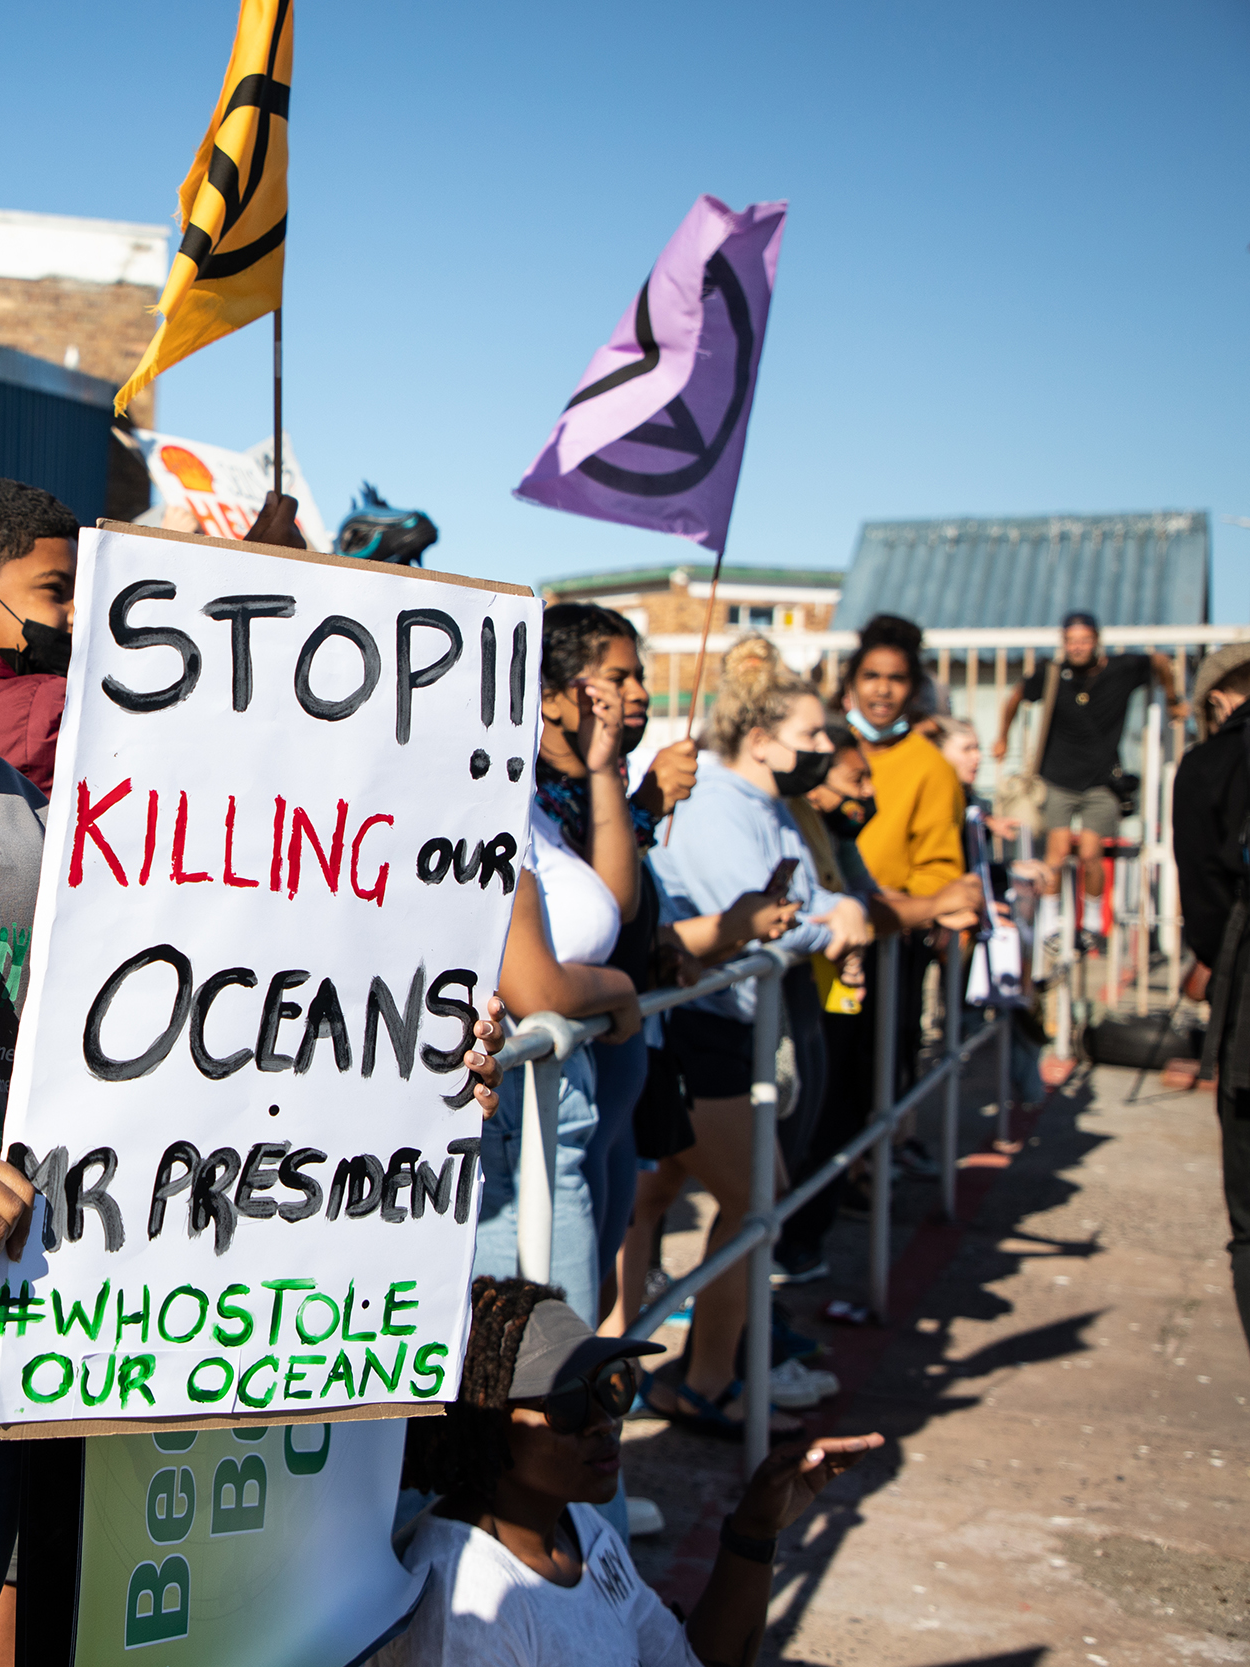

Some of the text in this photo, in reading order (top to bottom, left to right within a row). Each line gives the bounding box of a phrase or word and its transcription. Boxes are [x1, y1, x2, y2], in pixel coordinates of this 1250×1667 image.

[102, 579, 528, 783] STOP!!
[67, 777, 518, 907] KILLING OUR
[7, 1137, 482, 1257] MR PRESIDENT
[21, 1341, 450, 1409] OUR OCEANS
